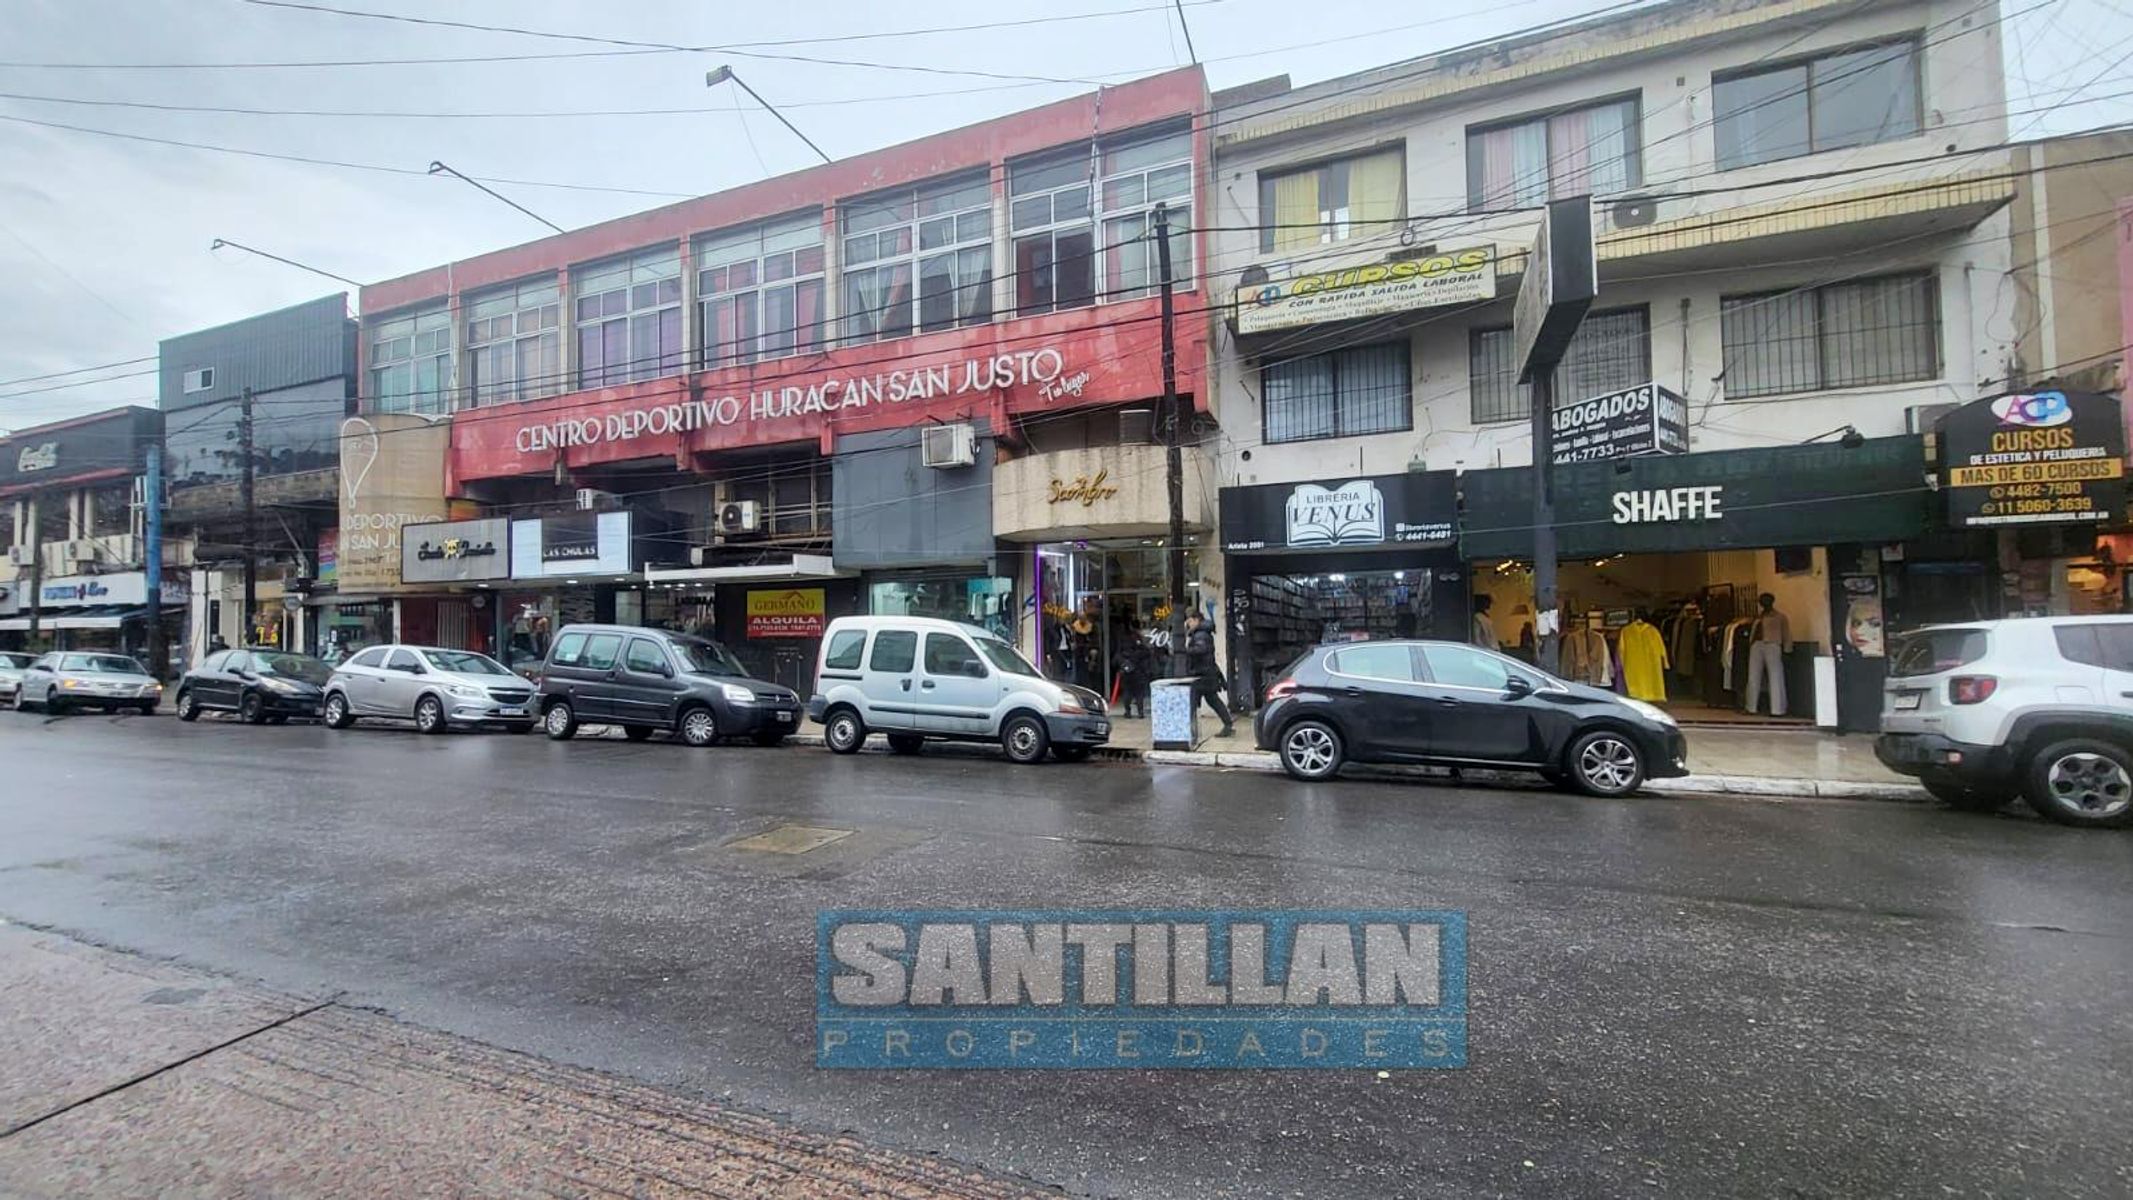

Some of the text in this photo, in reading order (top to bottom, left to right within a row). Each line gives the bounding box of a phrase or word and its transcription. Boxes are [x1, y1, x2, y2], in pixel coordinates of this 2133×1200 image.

[1291, 249, 1488, 297] CURSOS
[1289, 299, 1313, 308] CON
[1319, 290, 1366, 304] RAPIDA
[1371, 283, 1417, 296] SALIDA
[1423, 273, 1484, 288] LABORAL
[516, 348, 1065, 453] CENTRO DEPORTIVO HURACAN SAN JUSTO
[1552, 388, 1650, 431] ABOGADOS
[1991, 428, 2075, 452] CURSOS
[1969, 447, 2107, 465] DE ESTETICA Y PELUQUERIA
[1960, 461, 2111, 484] MAS DE 60 CURSOS
[1306, 491, 1360, 504] LIBRERIA
[2006, 482, 2082, 498] 4482-7500
[1293, 502, 1376, 524] VENUS
[1612, 485, 1722, 524] SHAFFE
[1999, 498, 2092, 513] 11 5060-3639
[753, 616, 817, 625] ALQUILA
